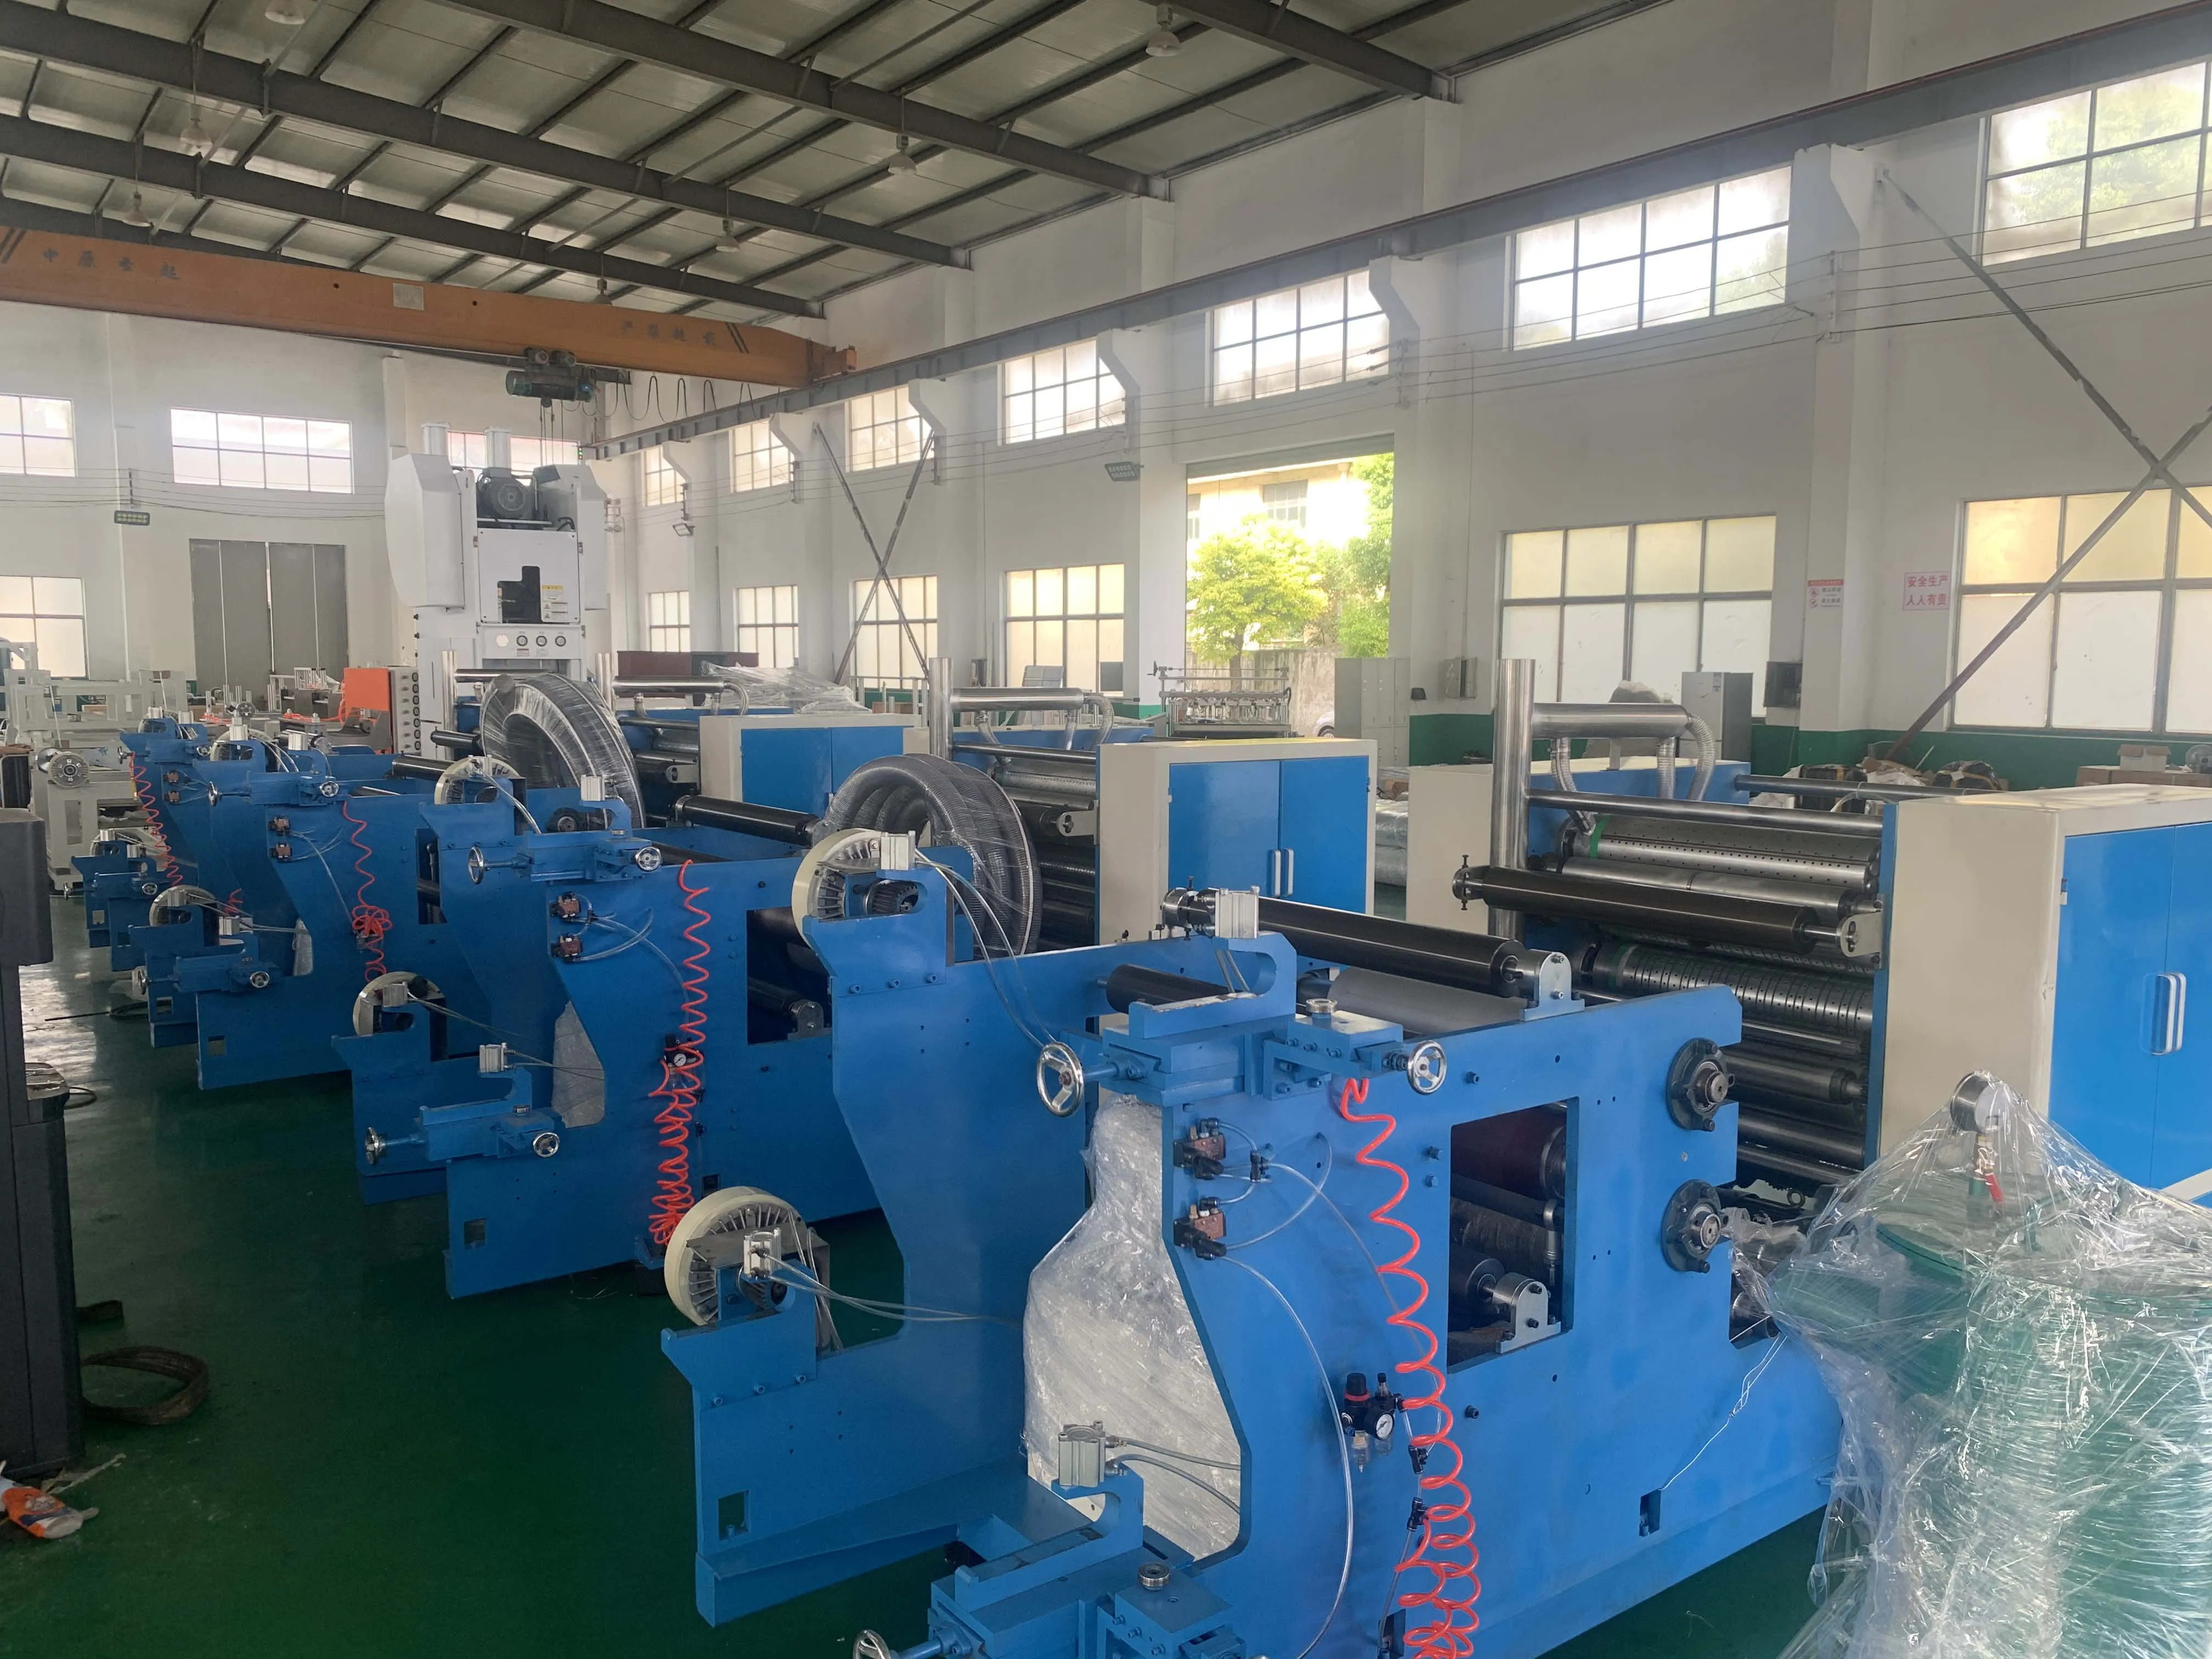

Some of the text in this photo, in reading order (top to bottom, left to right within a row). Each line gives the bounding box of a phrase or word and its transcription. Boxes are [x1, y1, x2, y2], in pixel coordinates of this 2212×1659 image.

[1907, 574, 1948, 588] 安全生产
[1906, 594, 1946, 606] 人人有责
